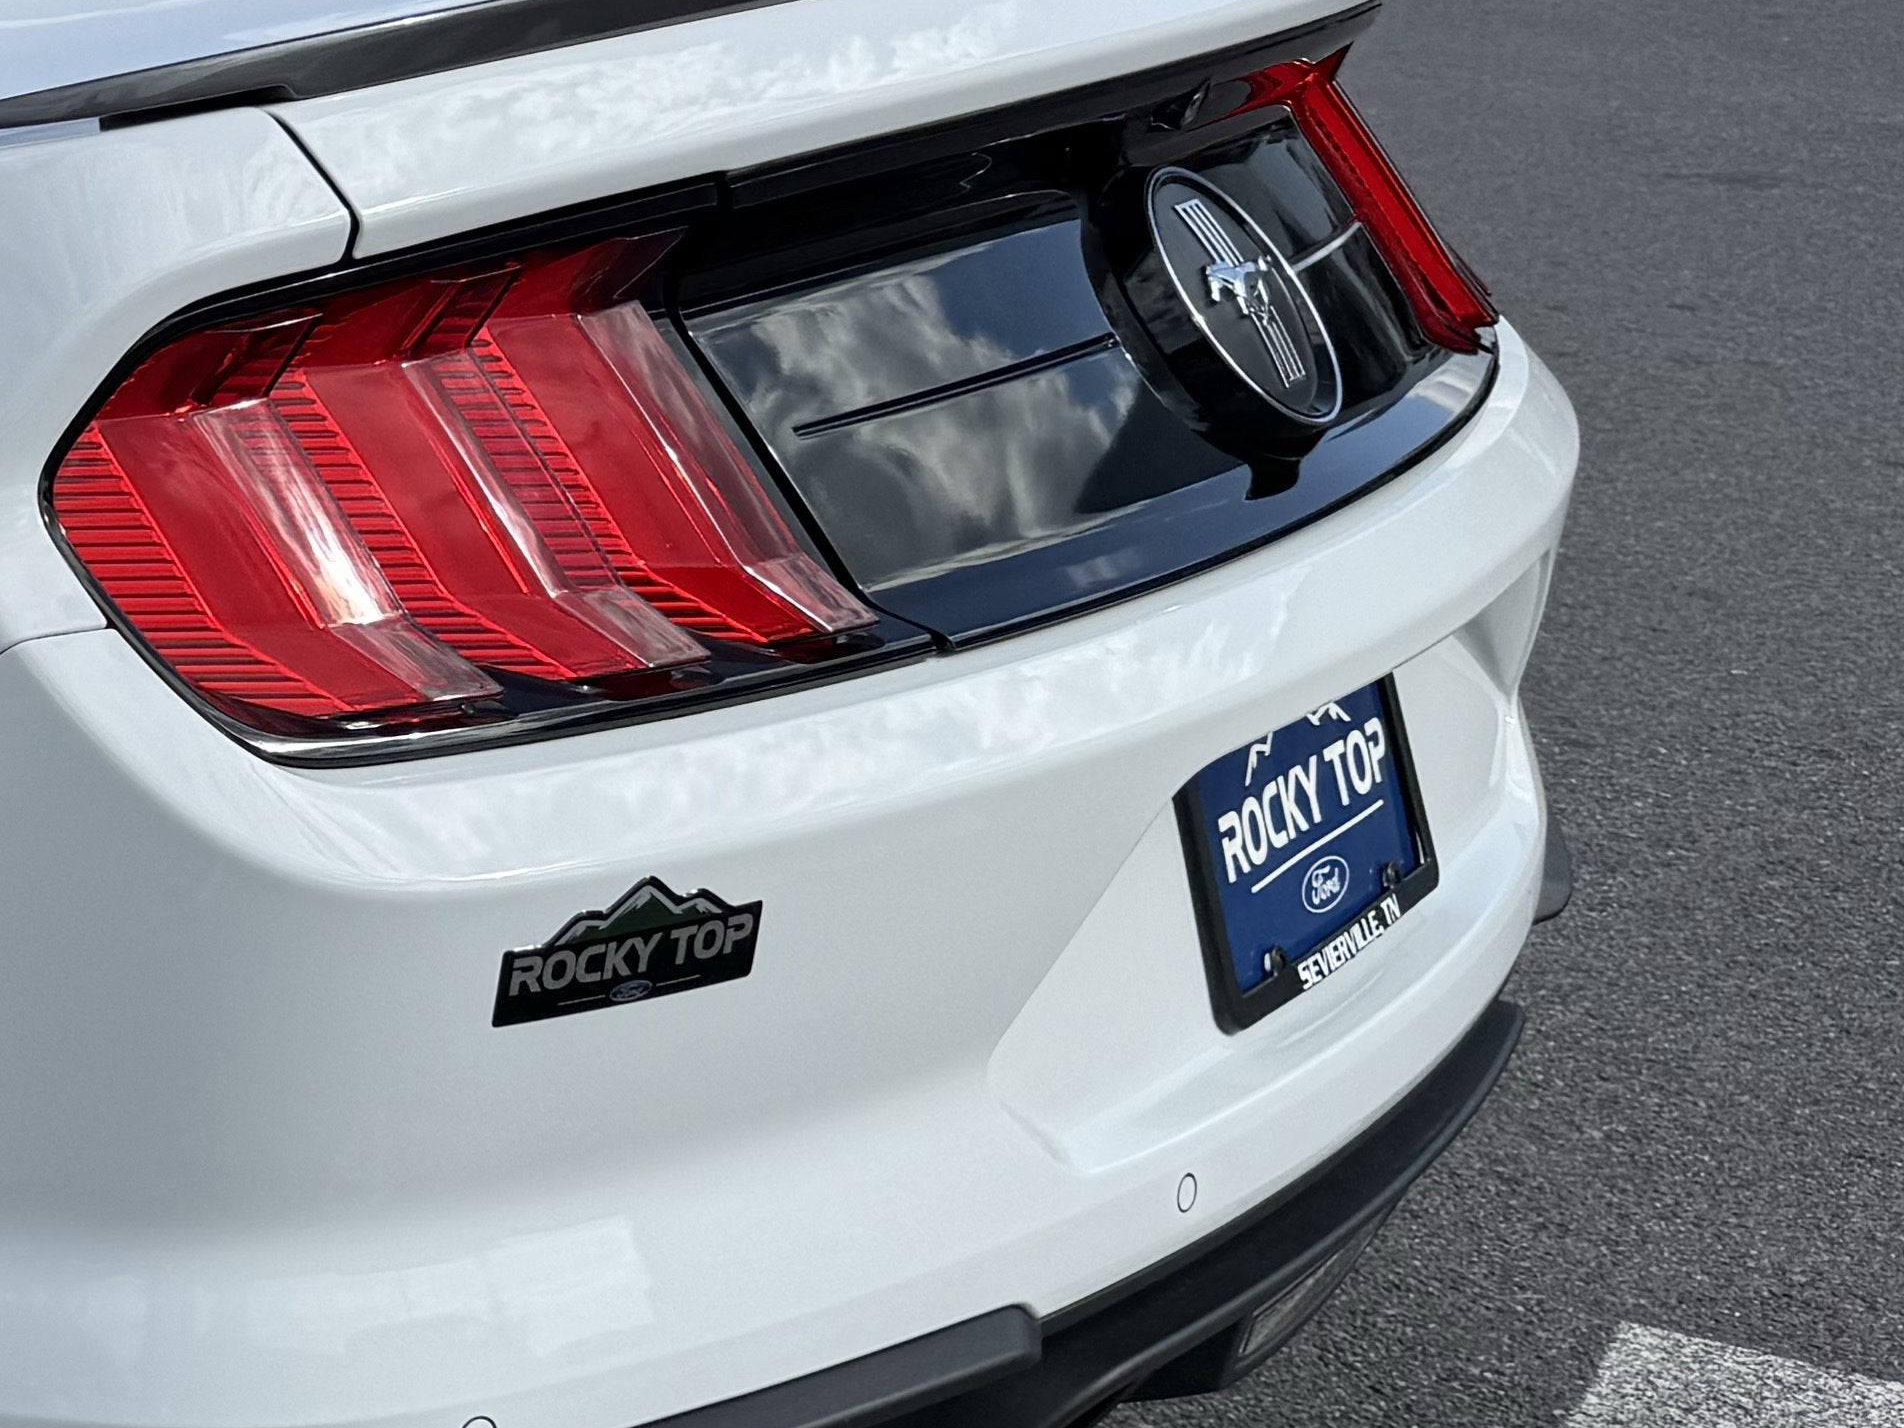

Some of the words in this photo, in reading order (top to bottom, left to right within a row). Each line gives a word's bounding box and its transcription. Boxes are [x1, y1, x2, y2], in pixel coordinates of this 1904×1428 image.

[1217, 753, 1323, 885] ROCKY
[1322, 716, 1387, 807] TOP
[1311, 864, 1341, 906] Ford
[1379, 891, 1402, 926] TN
[507, 932, 664, 998] ROCKY
[669, 912, 755, 966] TOP
